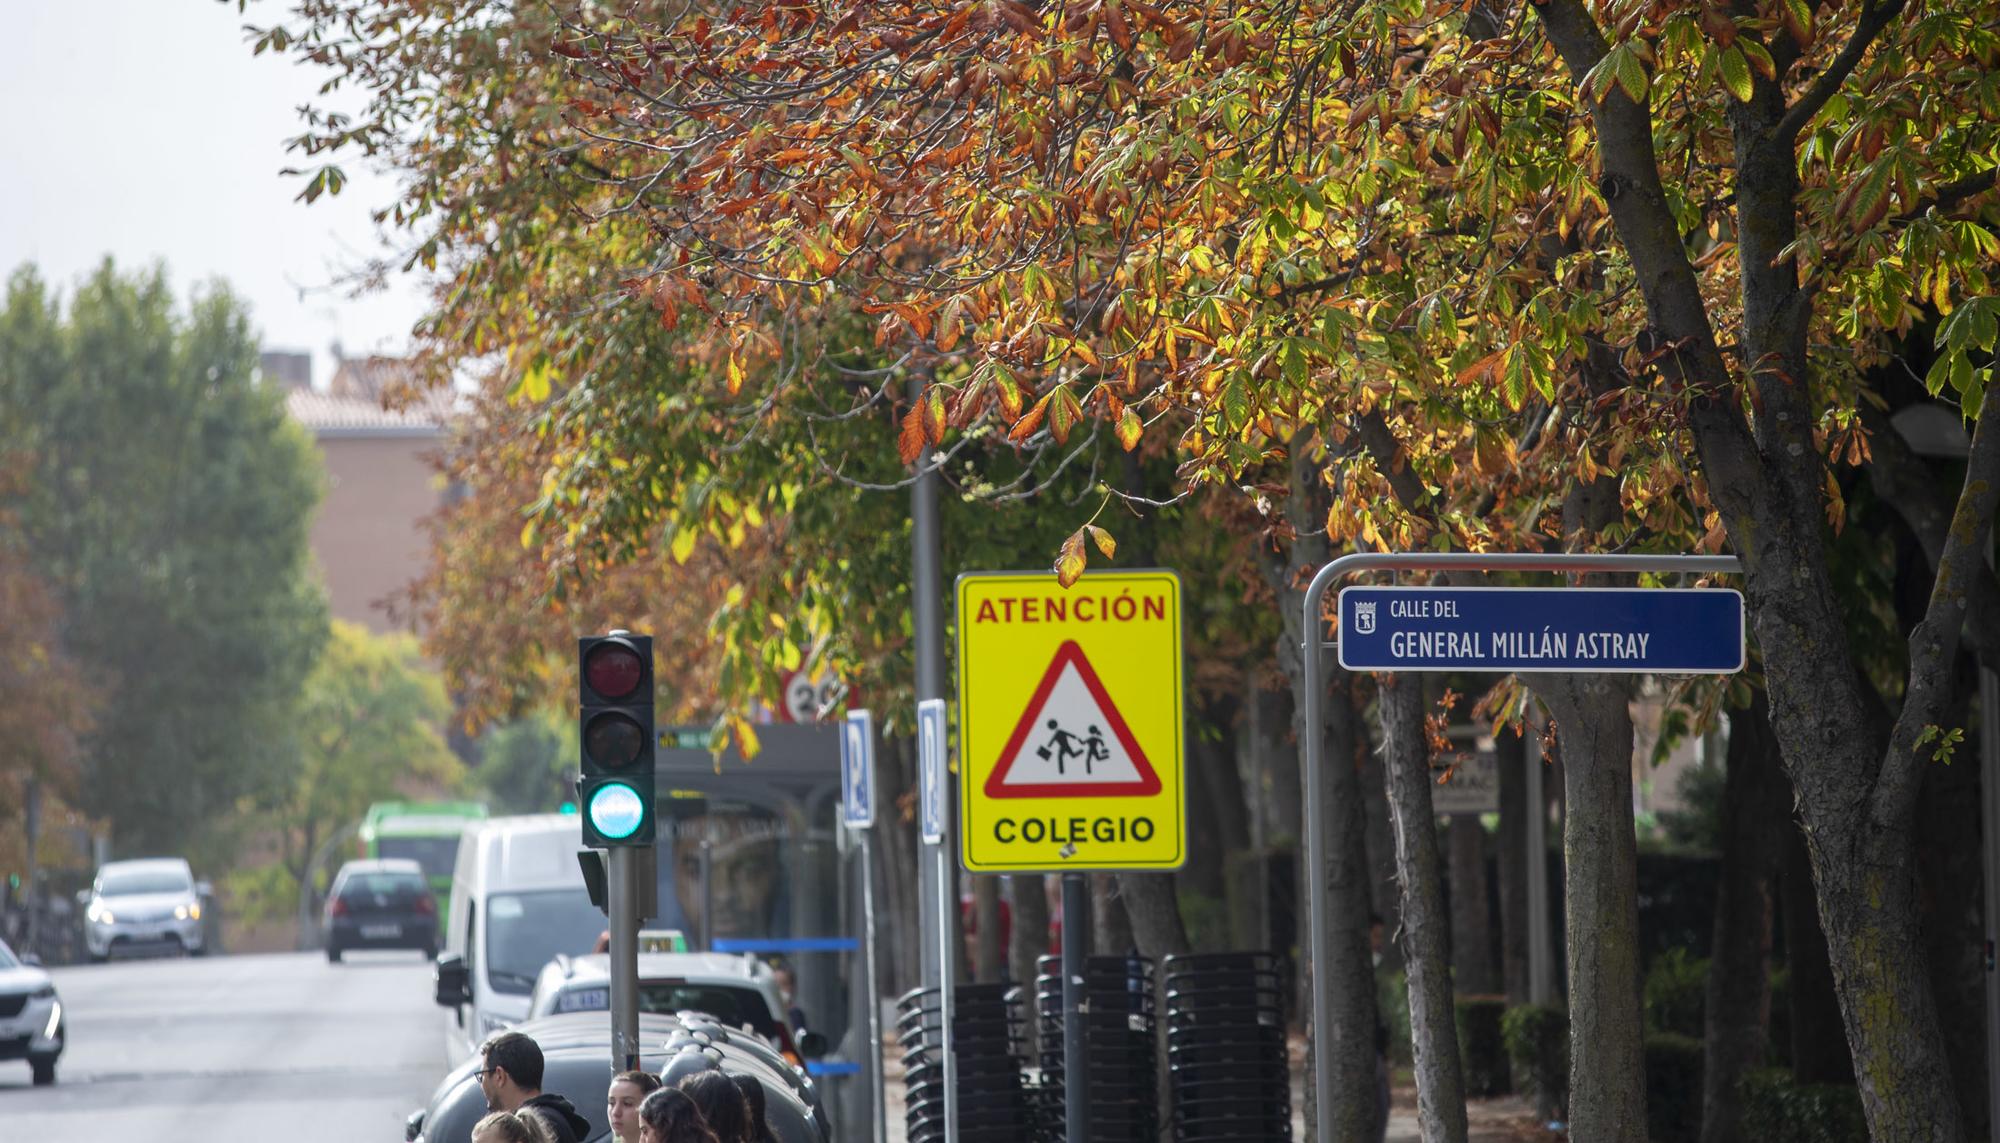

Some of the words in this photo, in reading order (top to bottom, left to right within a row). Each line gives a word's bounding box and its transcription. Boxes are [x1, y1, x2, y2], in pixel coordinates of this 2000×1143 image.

[975, 588, 1166, 623] ATENCIÓN
[1390, 600, 1430, 618] CALLE
[1433, 601, 1460, 618] DEL
[1390, 631, 1486, 658] GENERAL
[1492, 625, 1567, 658] MILLÁN
[1574, 633, 1650, 659] ASTRAY
[993, 816, 1155, 844] COLEGIO
